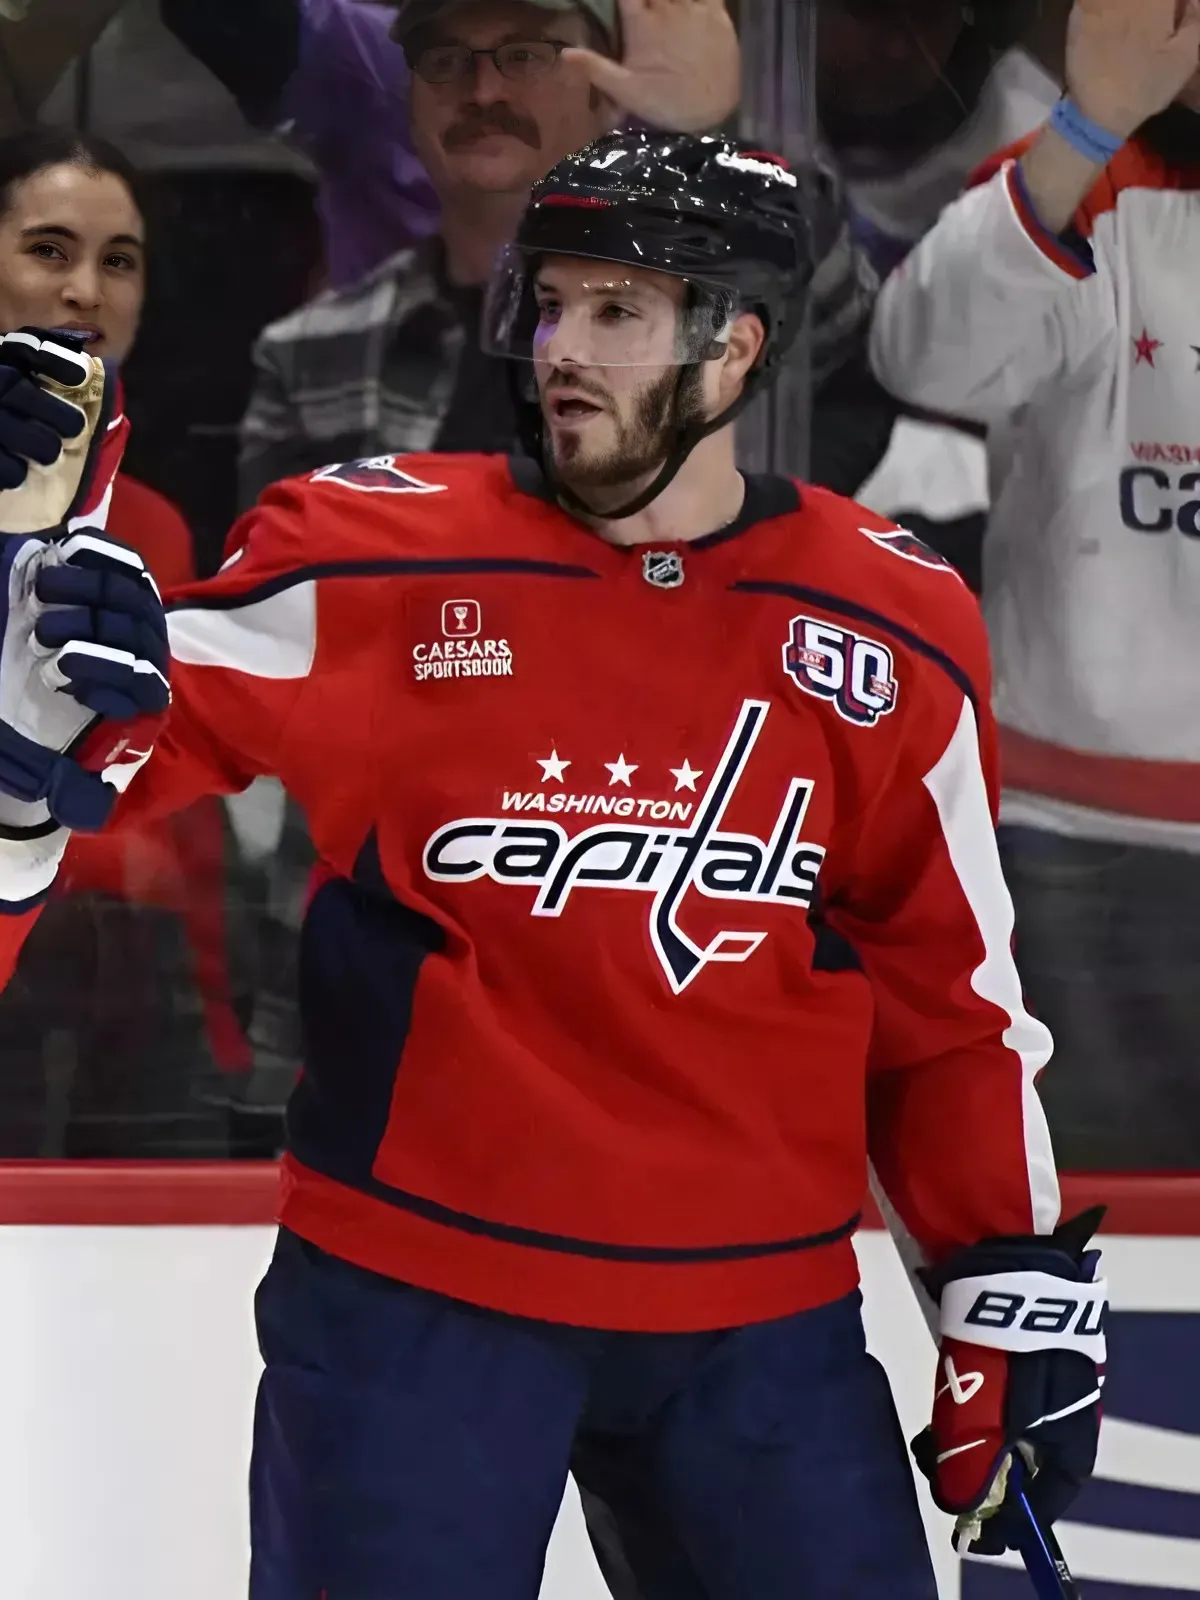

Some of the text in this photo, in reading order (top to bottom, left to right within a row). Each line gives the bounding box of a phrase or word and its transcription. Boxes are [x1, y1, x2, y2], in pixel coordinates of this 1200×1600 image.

[412, 638, 510, 661] CAESARS
[802, 620, 890, 710] 50
[501, 790, 694, 822] WASHINGTON
